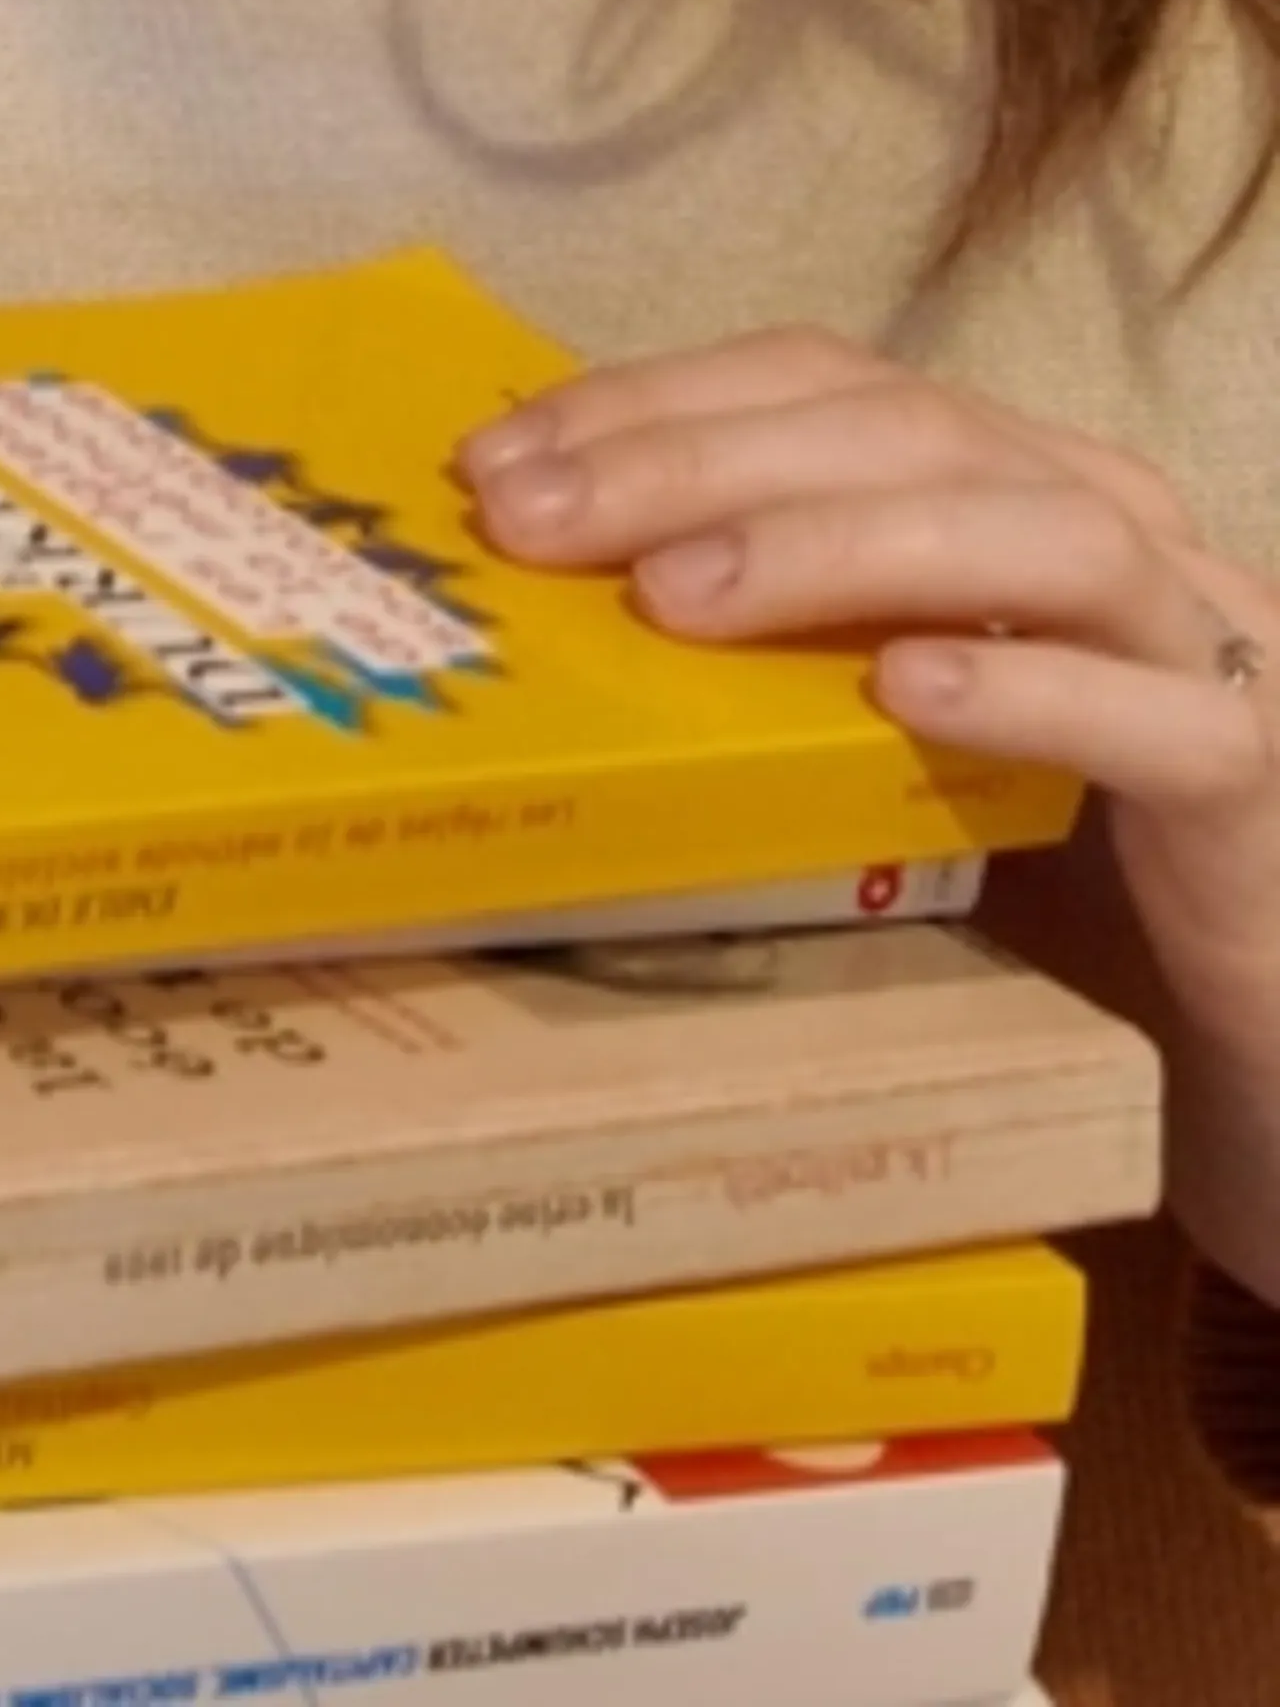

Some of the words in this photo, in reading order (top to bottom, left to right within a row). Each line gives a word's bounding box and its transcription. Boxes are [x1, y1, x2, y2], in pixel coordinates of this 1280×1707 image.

[248, 1205, 491, 1268] économique
[495, 1192, 594, 1237] crise
[428, 1617, 628, 1671] SCHUMPETER
[632, 1603, 747, 1647] JOSEPH
